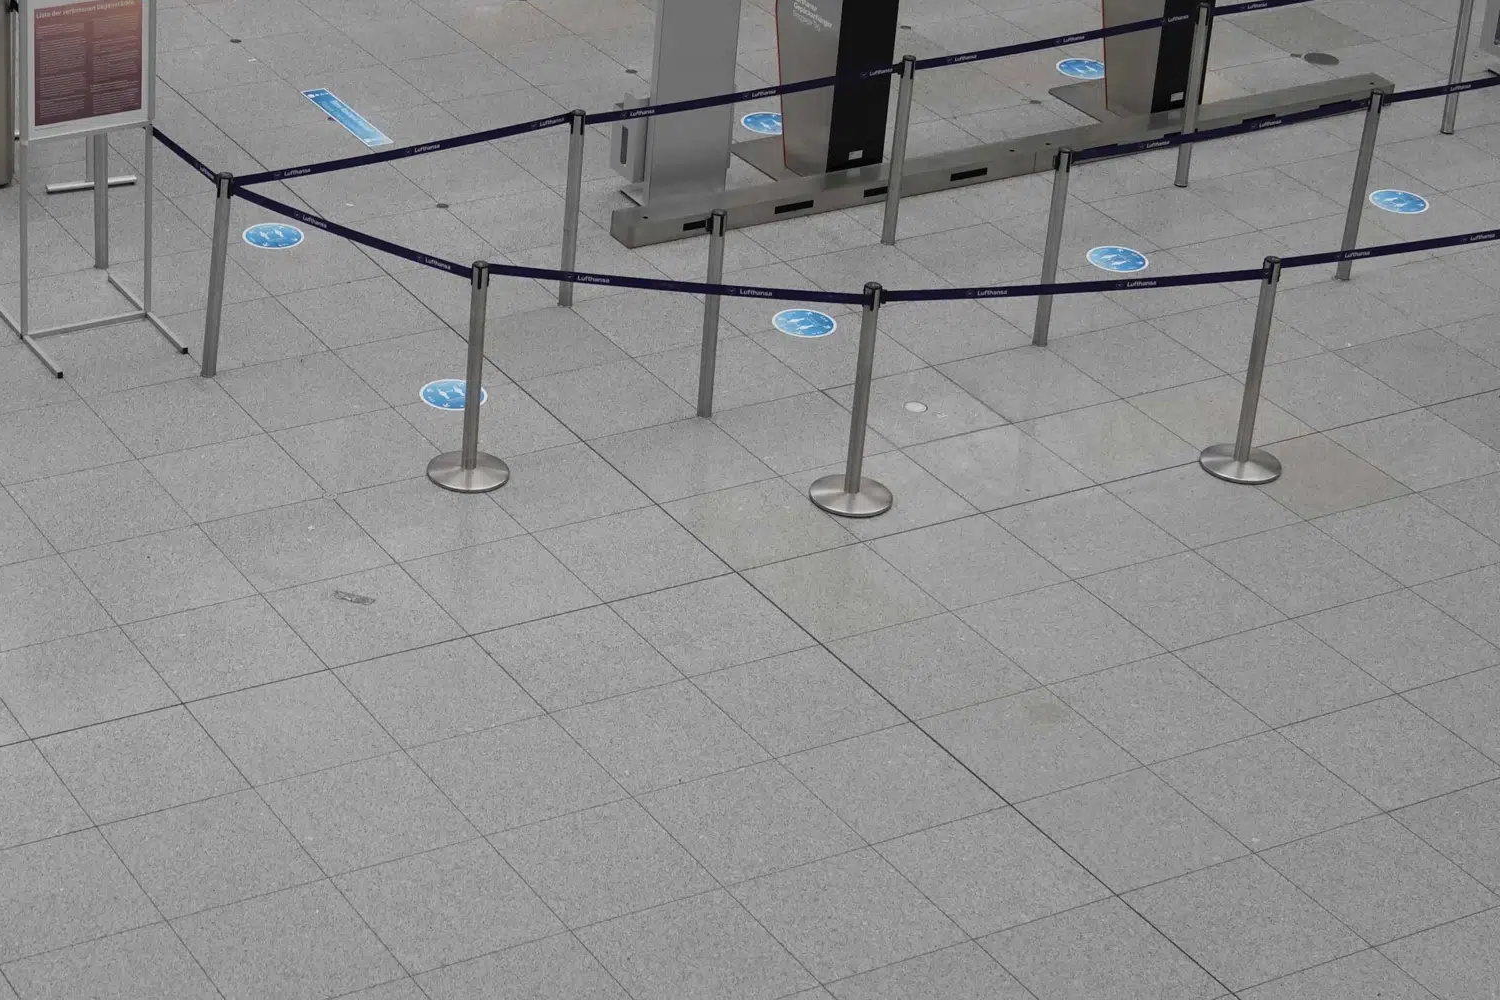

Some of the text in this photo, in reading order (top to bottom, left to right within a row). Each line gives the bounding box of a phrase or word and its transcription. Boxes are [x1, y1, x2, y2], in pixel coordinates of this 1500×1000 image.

[1063, 34, 1085, 43] Lufthansa
[954, 54, 977, 62] Lufthansa
[869, 67, 893, 76] Lufthansa
[751, 89, 776, 98] Lufthansa
[630, 108, 655, 117] Lufthansa
[539, 116, 565, 127] Lufthansa
[1258, 119, 1282, 128] Lufthansa
[414, 143, 441, 153] Lufthansa
[1146, 139, 1170, 149] Lufthansa
[284, 167, 311, 177] Lufthansa
[302, 214, 328, 229] Lufthansa
[1469, 232, 1496, 242] Lufthansa
[1344, 250, 1371, 259] Lufthansa
[425, 257, 452, 271] Lufthansa
[577, 275, 610, 284] Lufthansa
[1126, 280, 1157, 288] Lufthansa
[739, 287, 773, 297] Lufthansa
[977, 289, 1008, 297] Lufthansa
